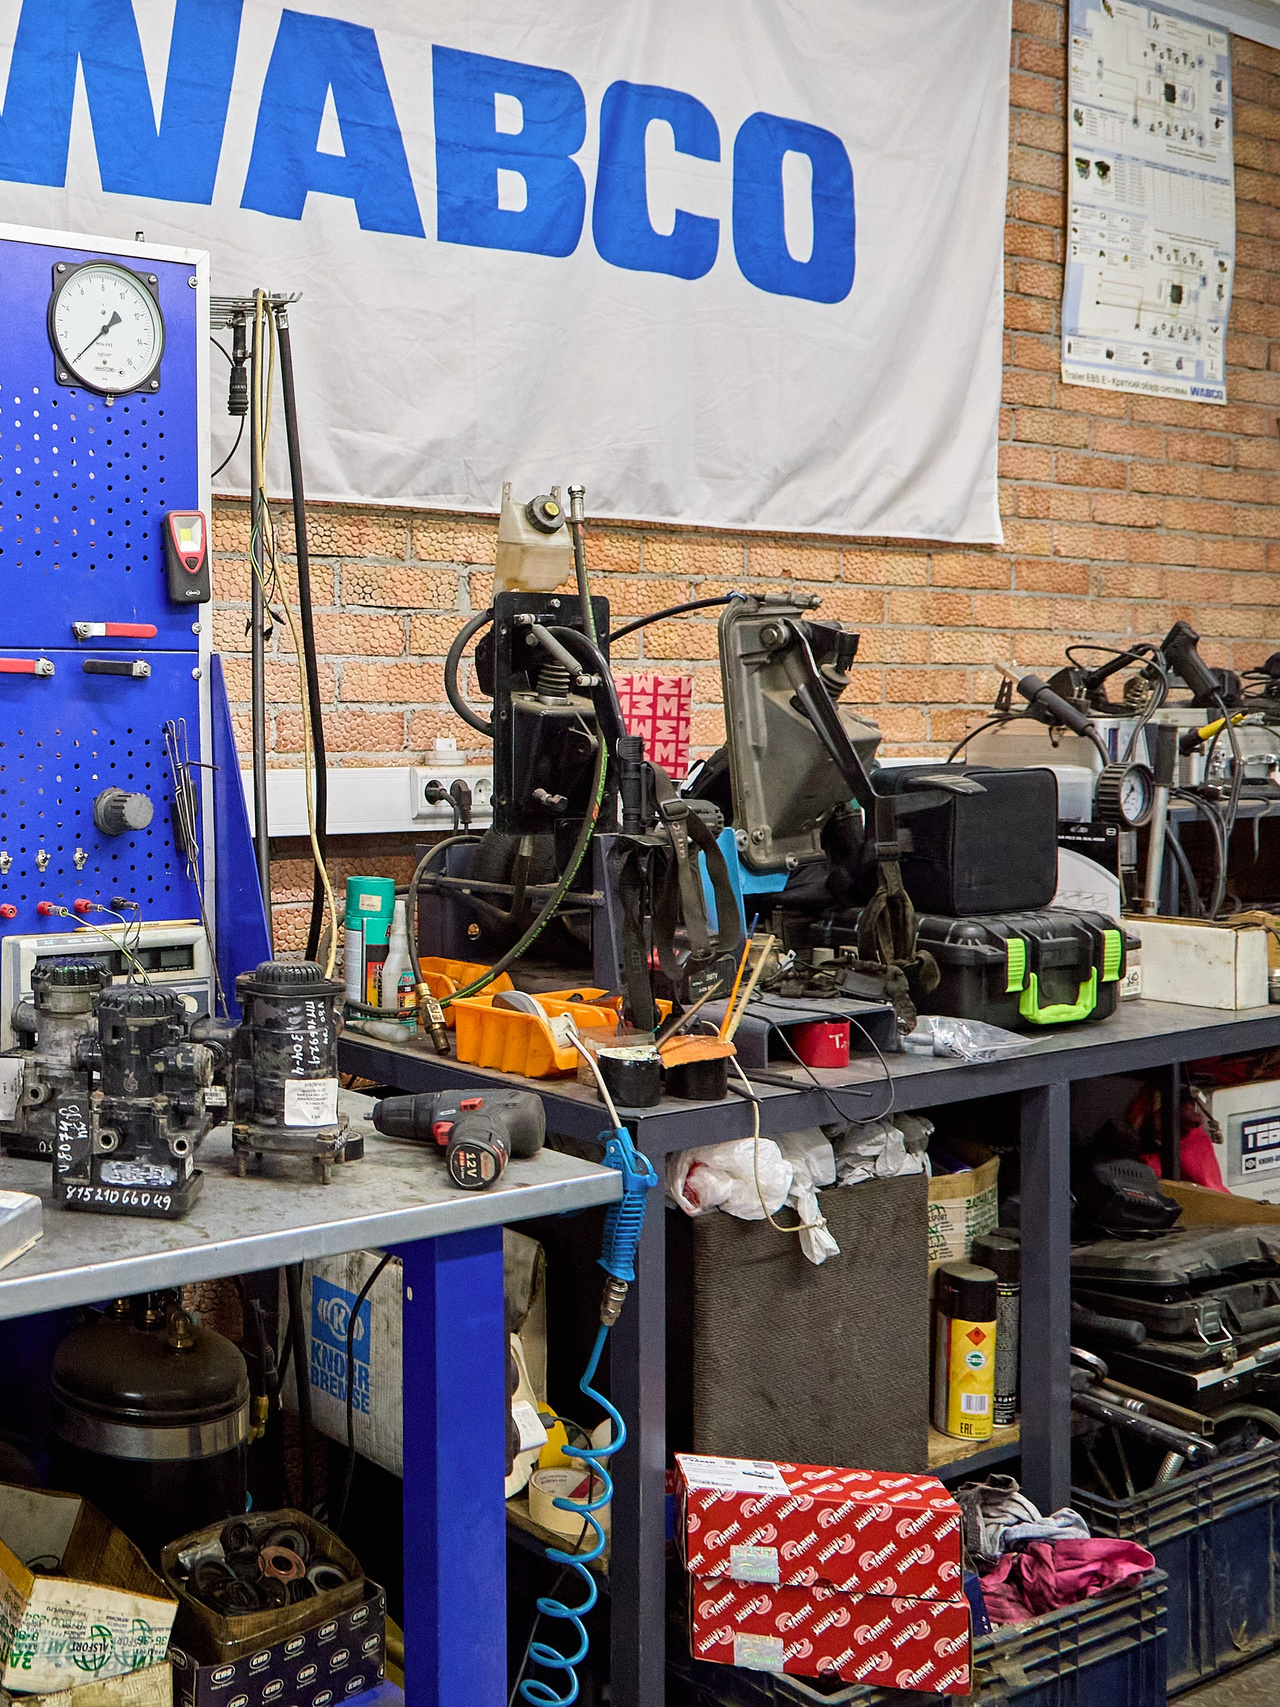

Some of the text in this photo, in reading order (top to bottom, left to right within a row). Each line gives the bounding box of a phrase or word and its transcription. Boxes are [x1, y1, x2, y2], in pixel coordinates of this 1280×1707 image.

[1087, 373, 1100, 383] EBS
[1190, 386, 1223, 399] WABCO
[466, 1152, 477, 1178] 12V
[311, 1339, 370, 1392] KNOR
[71, 1642, 109, 1652] ALSFORT
